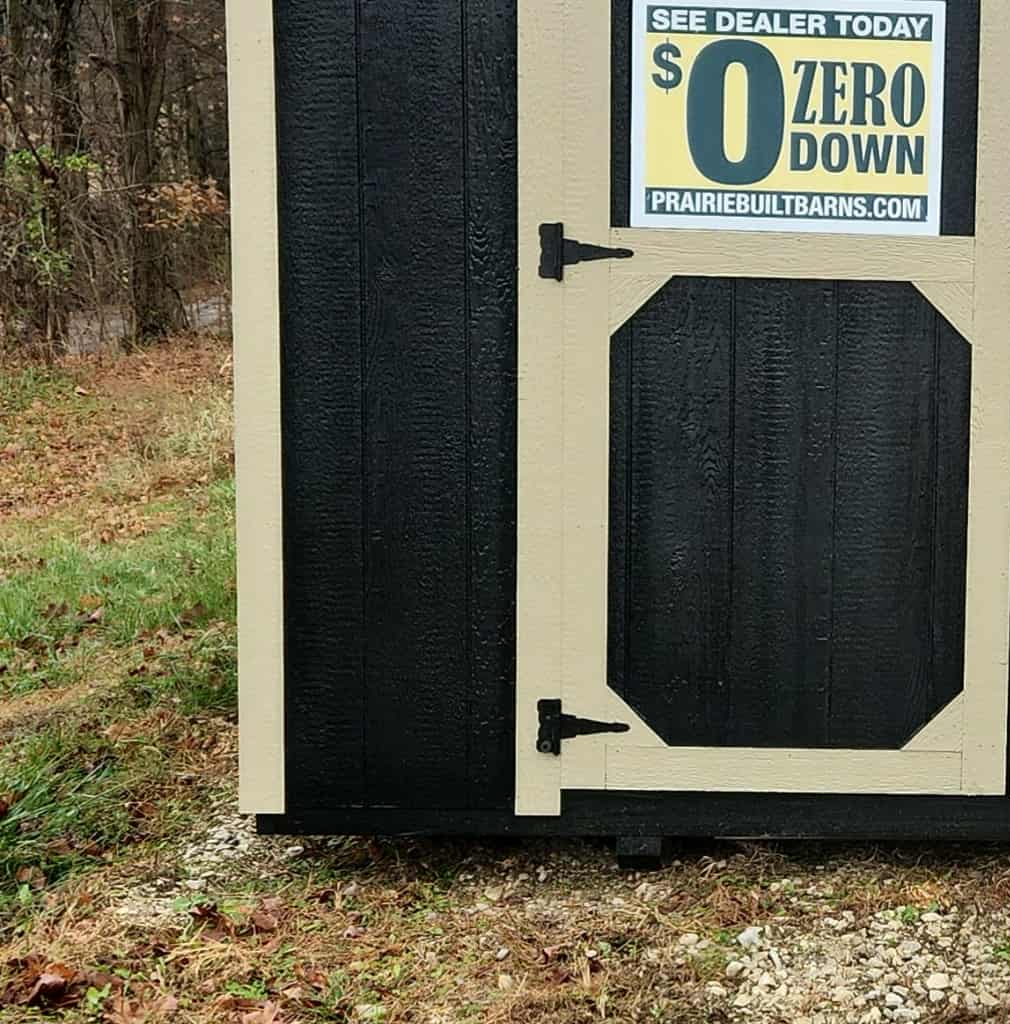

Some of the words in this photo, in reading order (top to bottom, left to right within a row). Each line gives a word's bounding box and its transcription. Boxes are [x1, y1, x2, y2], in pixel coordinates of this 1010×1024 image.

[652, 9, 706, 31] SEE
[716, 11, 826, 36] DEALER
[834, 14, 929, 38] TODAY
[792, 60, 925, 128] ZERO
[790, 131, 924, 175] DOWN
[651, 190, 921, 219] PRAIRIEBUILTBARNS.COM
